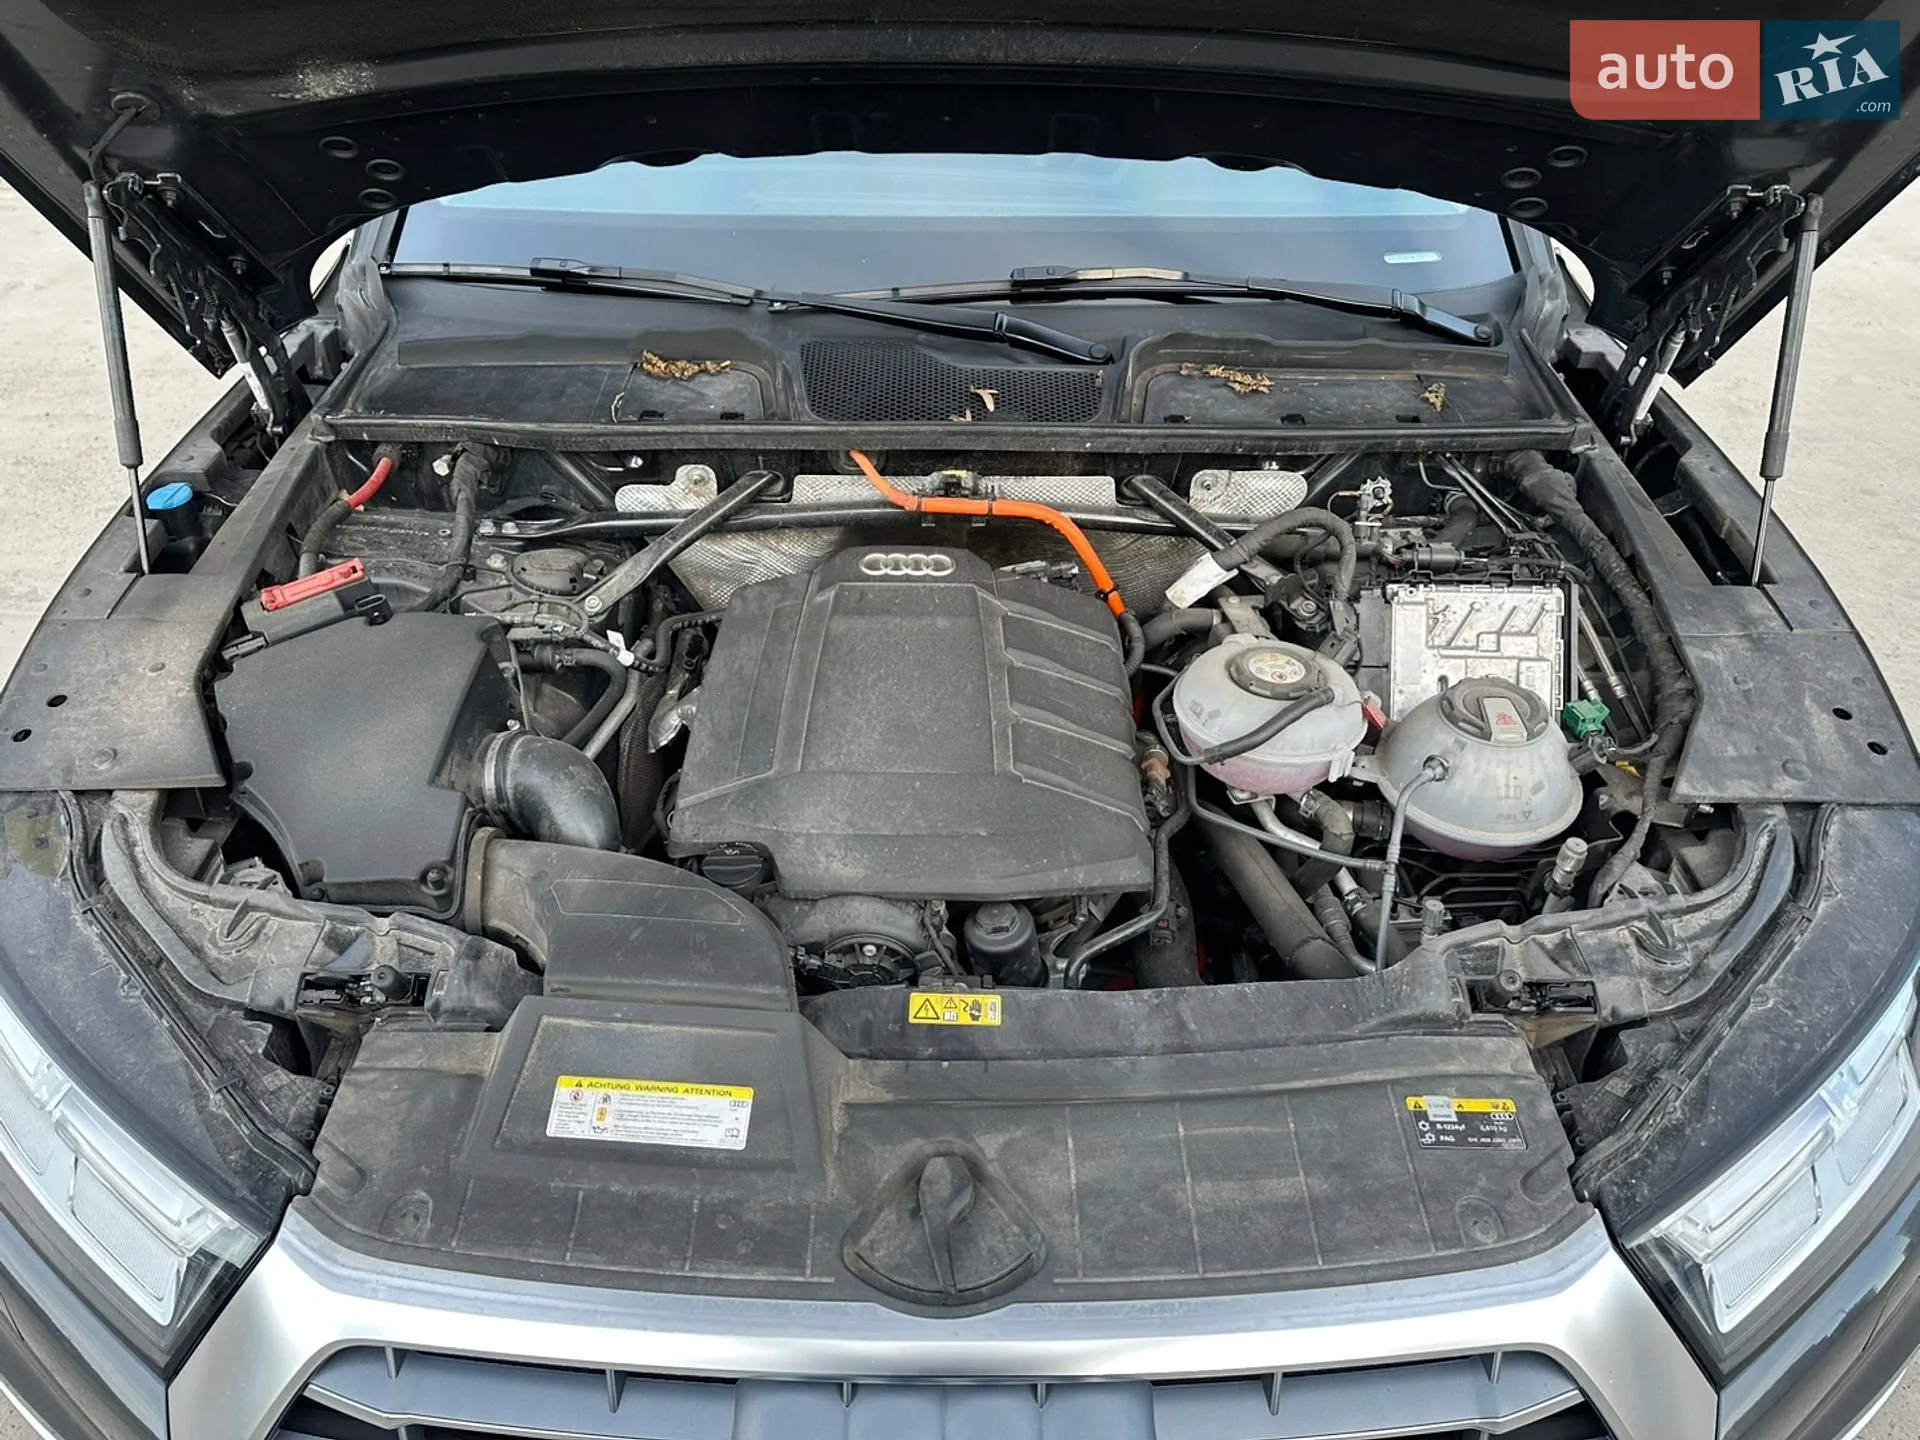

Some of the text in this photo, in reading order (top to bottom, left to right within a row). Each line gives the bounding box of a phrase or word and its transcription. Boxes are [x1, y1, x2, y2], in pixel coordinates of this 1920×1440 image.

[587, 1081, 733, 1098] ACHTUNG WARNING ATTENTION
